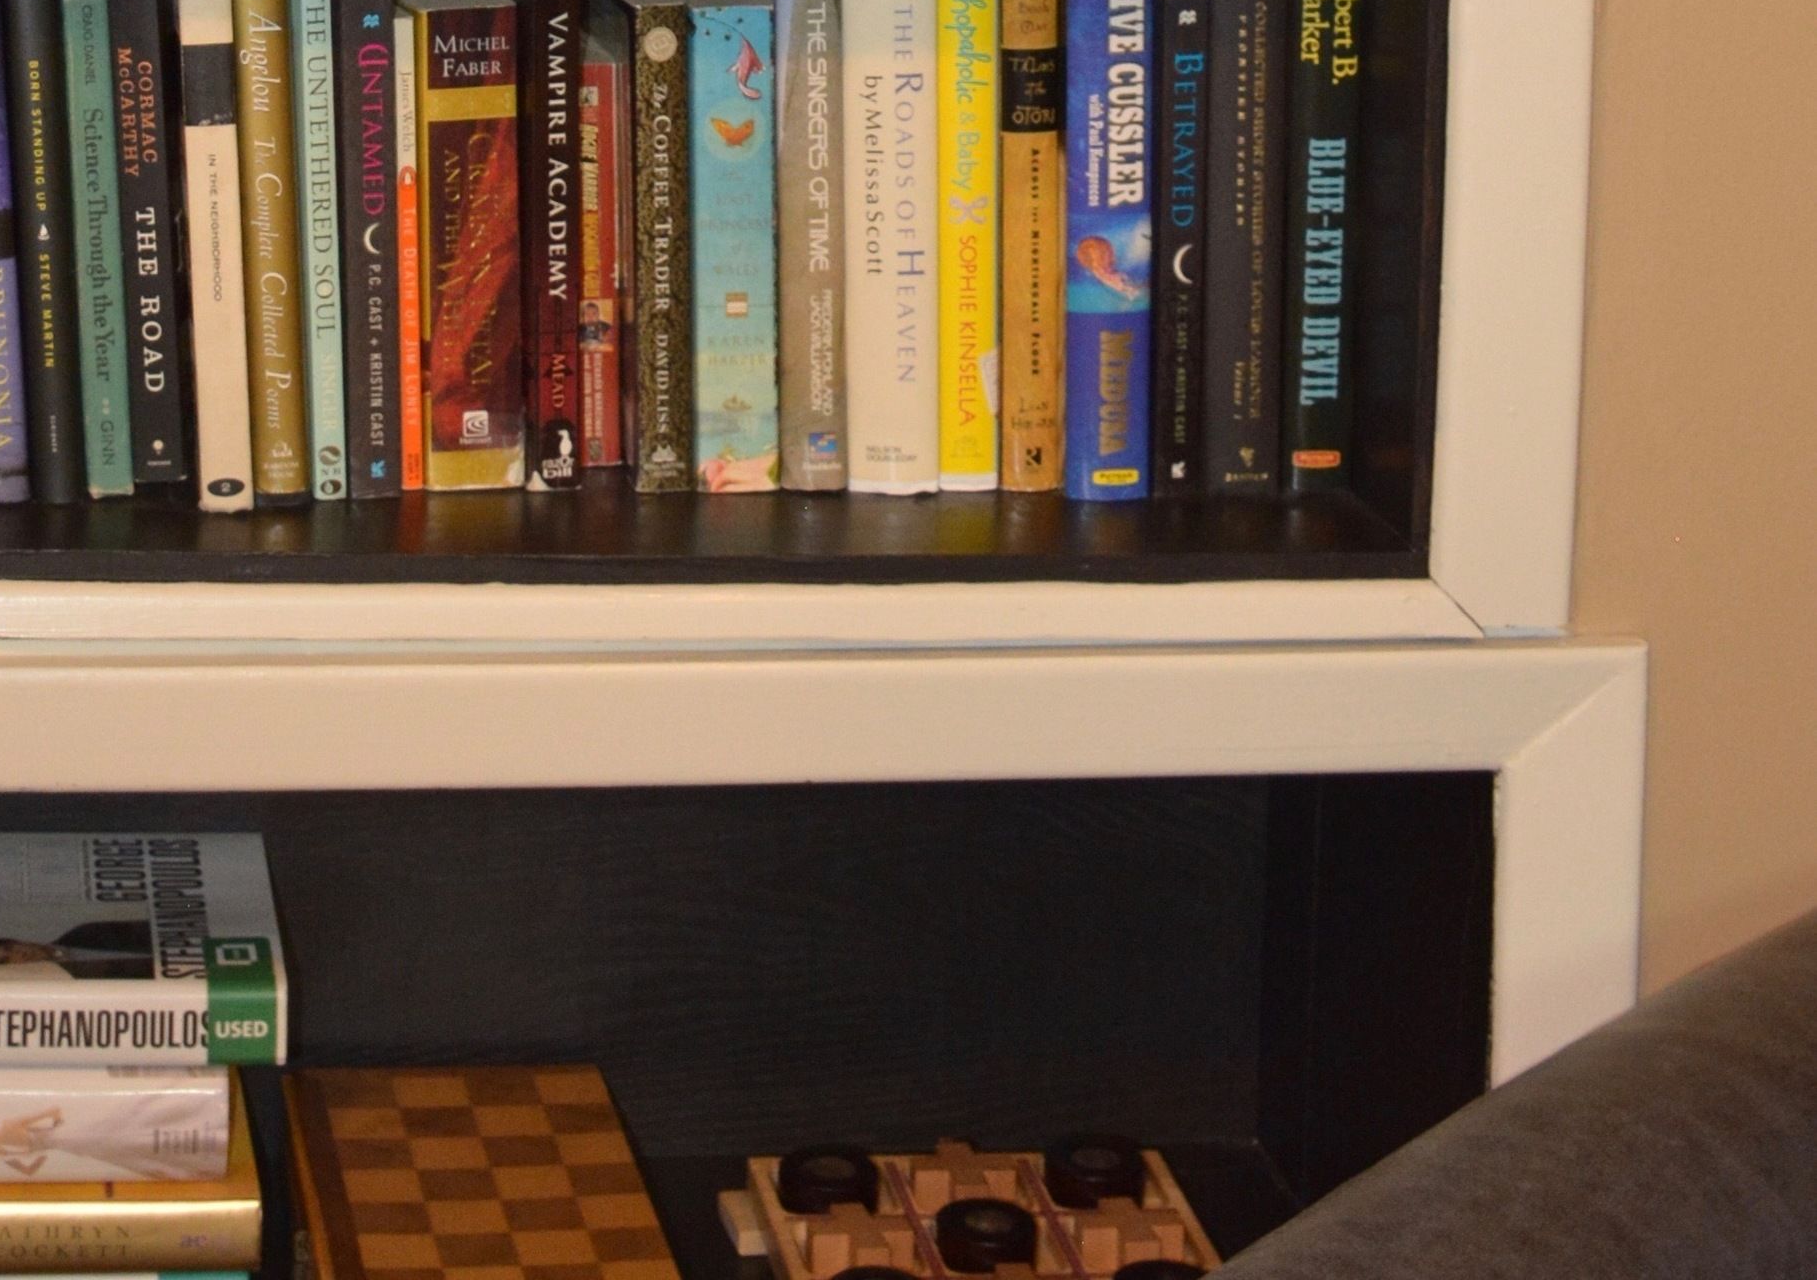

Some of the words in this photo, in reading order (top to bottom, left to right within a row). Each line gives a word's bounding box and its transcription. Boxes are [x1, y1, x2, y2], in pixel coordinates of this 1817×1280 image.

[434, 35, 510, 54] MICHEL
[442, 57, 503, 77] FABER
[547, 12, 569, 147] VAMPIRE
[1331, 57, 1358, 86] B.
[1107, 63, 1145, 208] CUSSLER
[135, 208, 159, 277] THE
[547, 159, 569, 301] ACADEMY
[1303, 138, 1346, 305] BLUE-EYED
[140, 296, 165, 394] ROAD
[1300, 318, 1339, 406] DEVIL
[216, 1019, 268, 1038] USED
